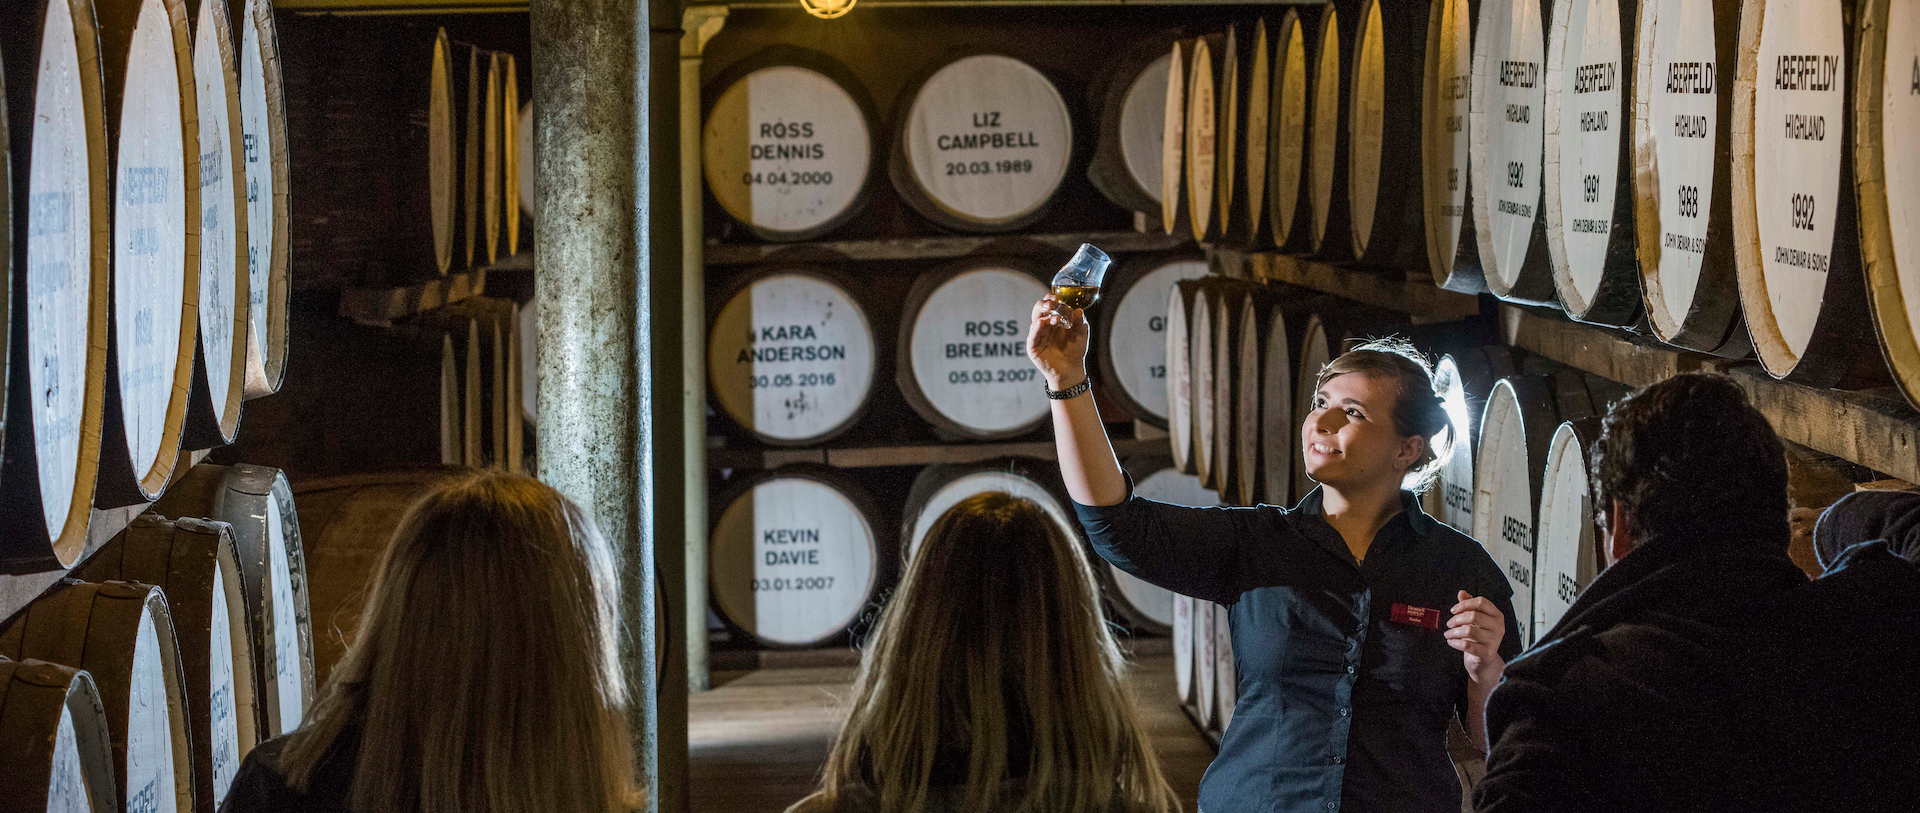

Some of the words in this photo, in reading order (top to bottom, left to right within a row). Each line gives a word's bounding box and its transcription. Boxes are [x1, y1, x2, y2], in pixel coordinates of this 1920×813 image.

[1500, 60, 1540, 89] ABERFELDY
[1574, 61, 1617, 94] ABERFELDY
[1666, 62, 1717, 94] ABERFELDY
[1775, 55, 1839, 92] ABERFELDY
[973, 111, 1001, 128] LIZ
[1506, 103, 1530, 124] HIGHLAND
[1581, 111, 1608, 132] HIGHLAND
[760, 122, 814, 138] ROSS
[1675, 115, 1706, 138] HIGHLAND
[1785, 114, 1825, 141] HIGHLAND
[937, 132, 1038, 150] CAMPBELL
[751, 143, 825, 160] DENNIS
[946, 159, 1033, 176] 20.03.1989
[1507, 161, 1524, 188] 1992
[742, 171, 833, 186] 04.04.2000
[1584, 175, 1600, 202] 1991
[1678, 184, 1698, 218] 1988
[1791, 193, 1815, 231] 1992
[1572, 219, 1581, 232] JOHN
[1598, 220, 1608, 234] SONS
[1664, 232, 1676, 249] JOHN
[1677, 234, 1691, 252] DEWAR
[1774, 246, 1789, 264] JOHN
[1789, 249, 1806, 269] DEWAR
[1812, 254, 1828, 273] SONS
[762, 325, 816, 341] KARA
[965, 320, 1018, 337] ROSS
[737, 345, 846, 363] ANDERSON
[749, 372, 836, 389] 30.05.2016
[948, 368, 1036, 384] 05.03.2007
[763, 529, 819, 544] KEVIN
[765, 549, 819, 566] DAVIE
[1509, 559, 1530, 588] HIGHLAND
[750, 576, 834, 592] 03.01.2007
